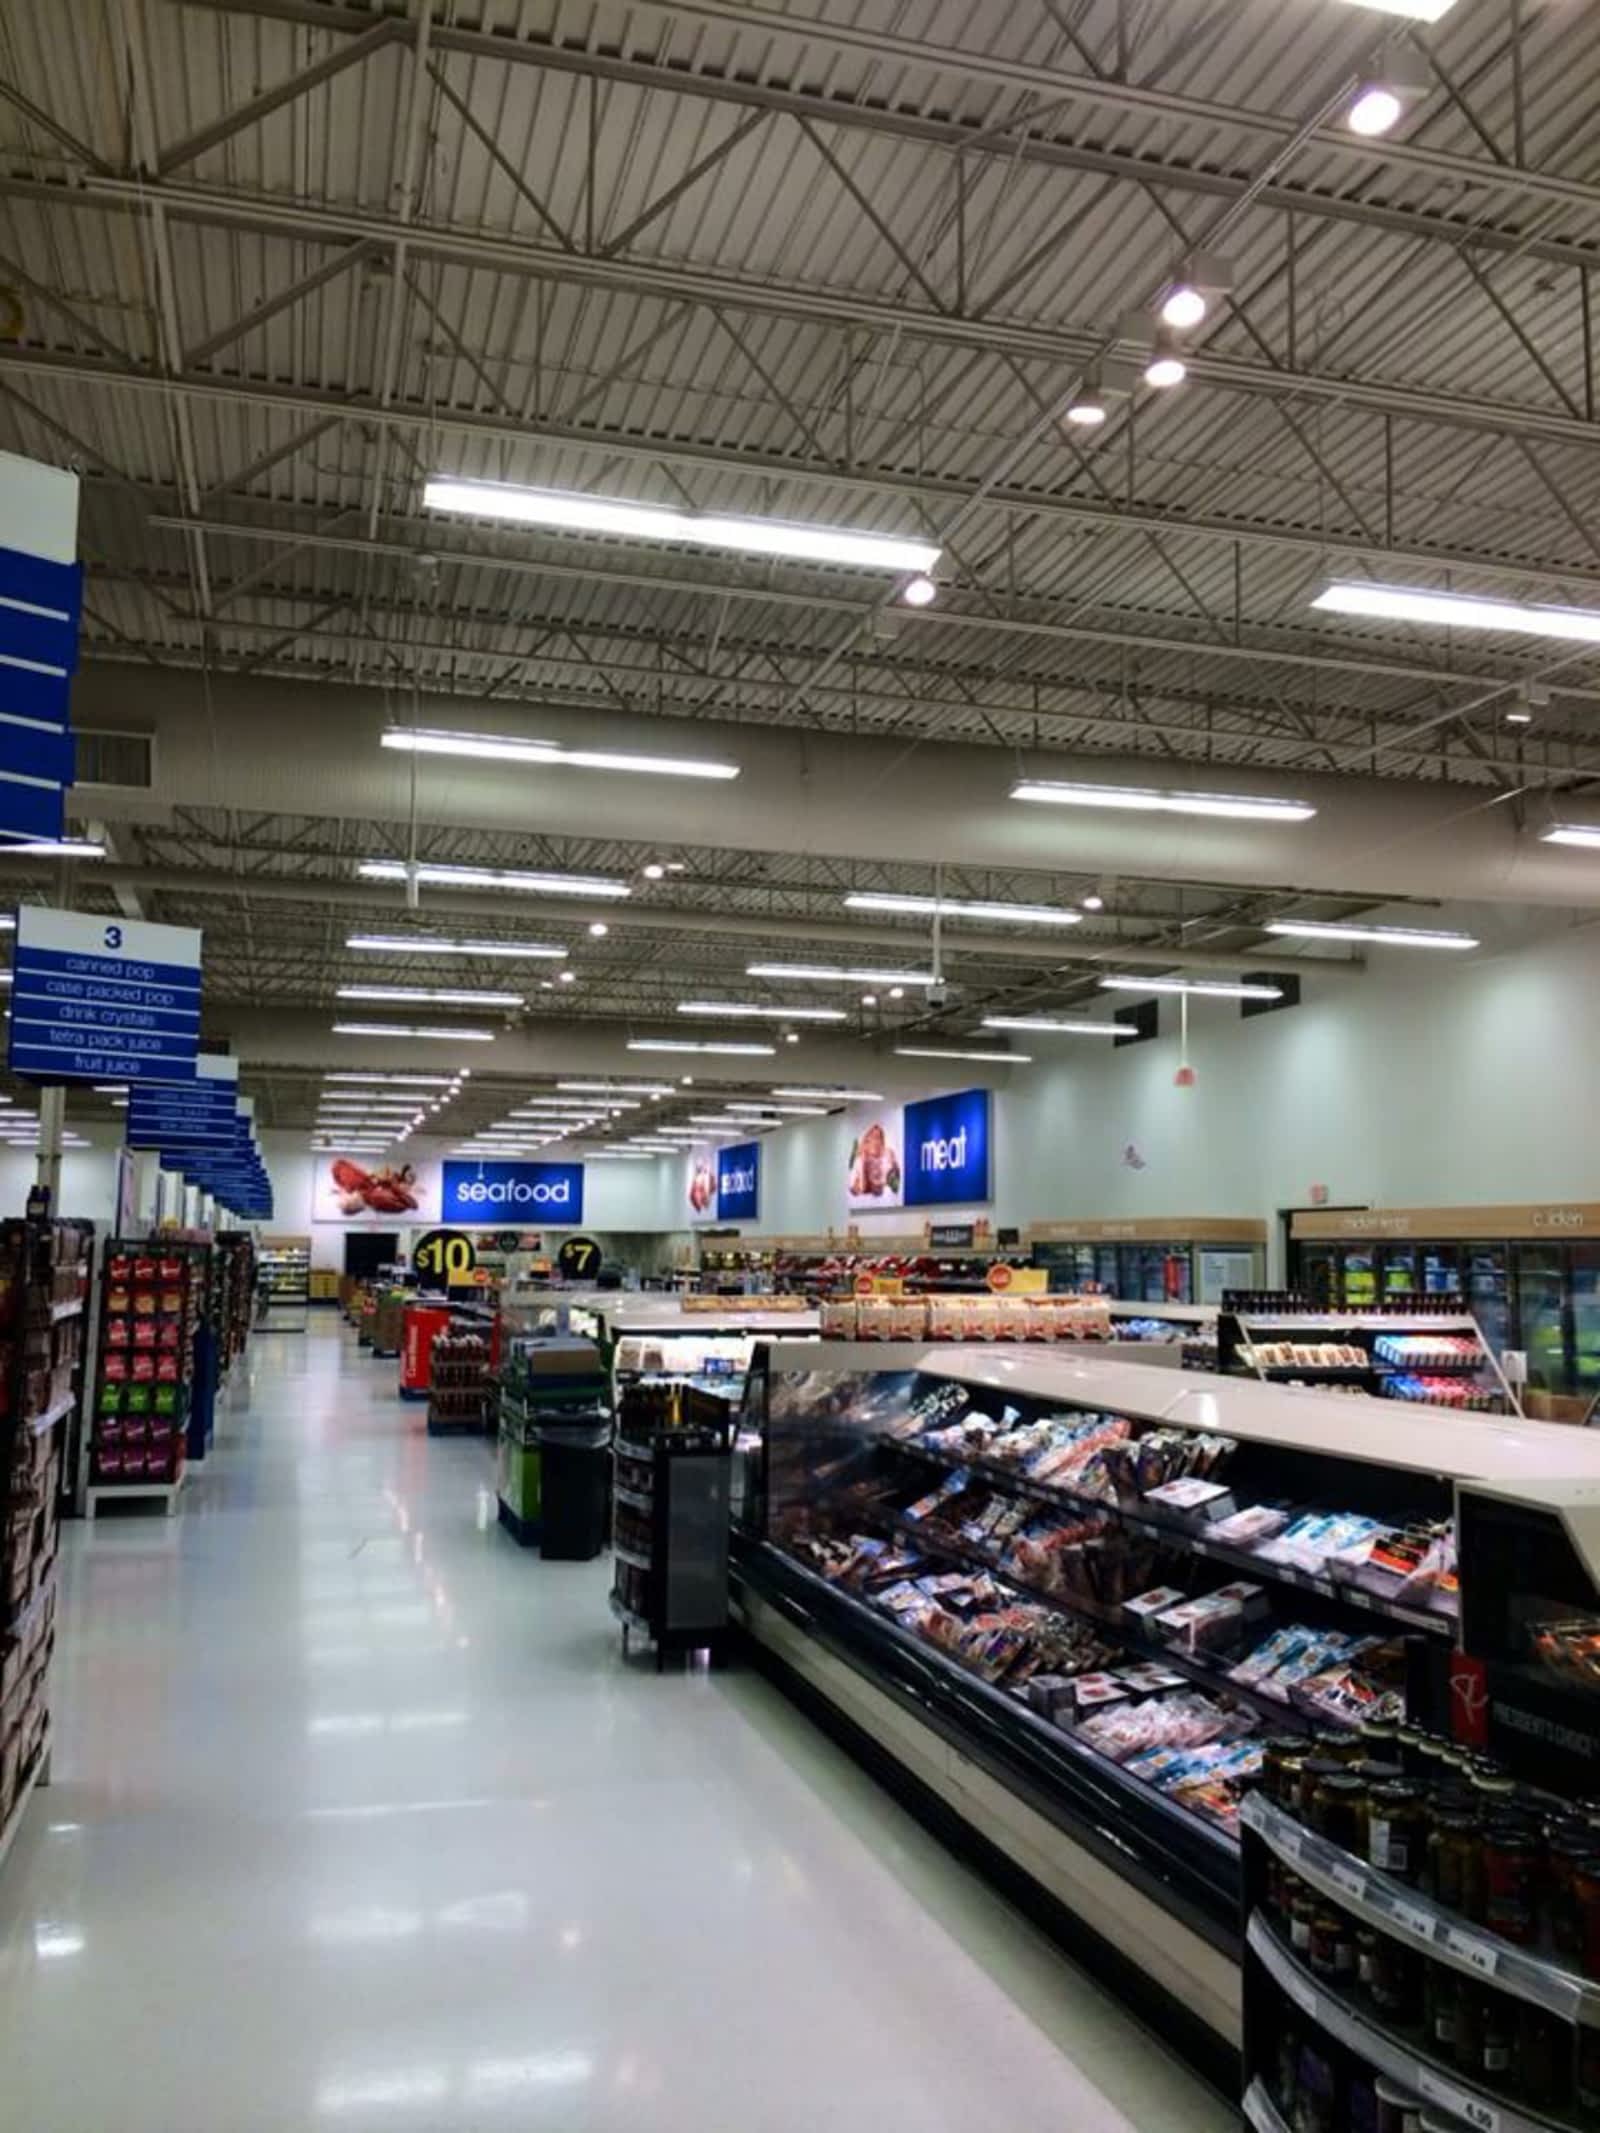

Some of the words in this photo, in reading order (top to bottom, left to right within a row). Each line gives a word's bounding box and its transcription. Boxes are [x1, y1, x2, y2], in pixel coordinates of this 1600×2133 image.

[104, 926, 122, 949] 3
[65, 957, 122, 976] canned
[125, 964, 154, 980] pop
[45, 980, 83, 995] case
[86, 985, 141, 1002] packed
[145, 991, 174, 1006] pop
[59, 1005, 97, 1021] drink
[101, 1009, 155, 1027] crystals
[50, 1028, 84, 1044] tetra
[88, 1032, 126, 1047] pack
[127, 1036, 162, 1051] juice
[75, 1054, 101, 1069] fruit
[105, 1058, 140, 1073] juice
[920, 1125, 967, 1172] meat
[456, 1178, 570, 1202] seafood
[416, 1238, 470, 1274] $10
[565, 1243, 593, 1272] $7
